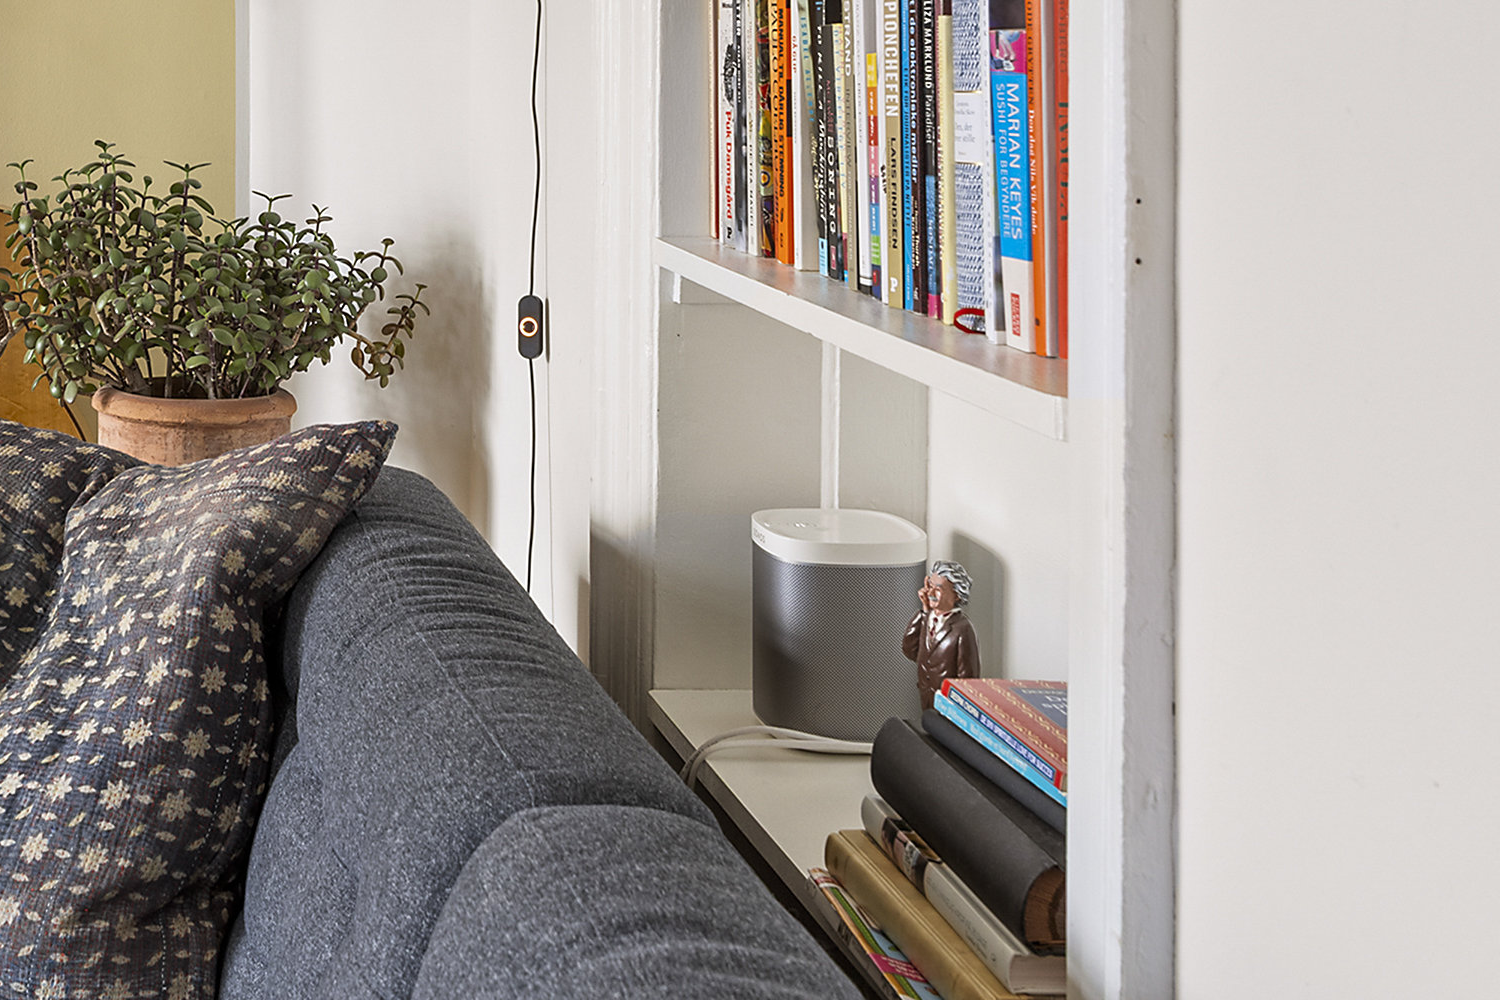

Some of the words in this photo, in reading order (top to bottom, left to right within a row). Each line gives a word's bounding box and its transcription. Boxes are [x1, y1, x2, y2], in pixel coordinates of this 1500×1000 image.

[843, 0, 852, 77] STRAND
[923, 0, 932, 24] LIZA
[909, 38, 917, 129] elektroniske
[923, 28, 935, 89] MARKLUND
[1027, 36, 1035, 106] GRYTTEN
[925, 93, 934, 144] Paradiset
[995, 83, 1006, 123] SUSHI
[1006, 83, 1021, 168] MARIAN
[910, 132, 919, 183] medier
[998, 129, 1007, 154] FOR
[725, 141, 733, 220] Damsgård
[999, 159, 1012, 239] BEGYNDERE
[1009, 177, 1023, 241] KEYES
[891, 183, 899, 249] FINDSEN
